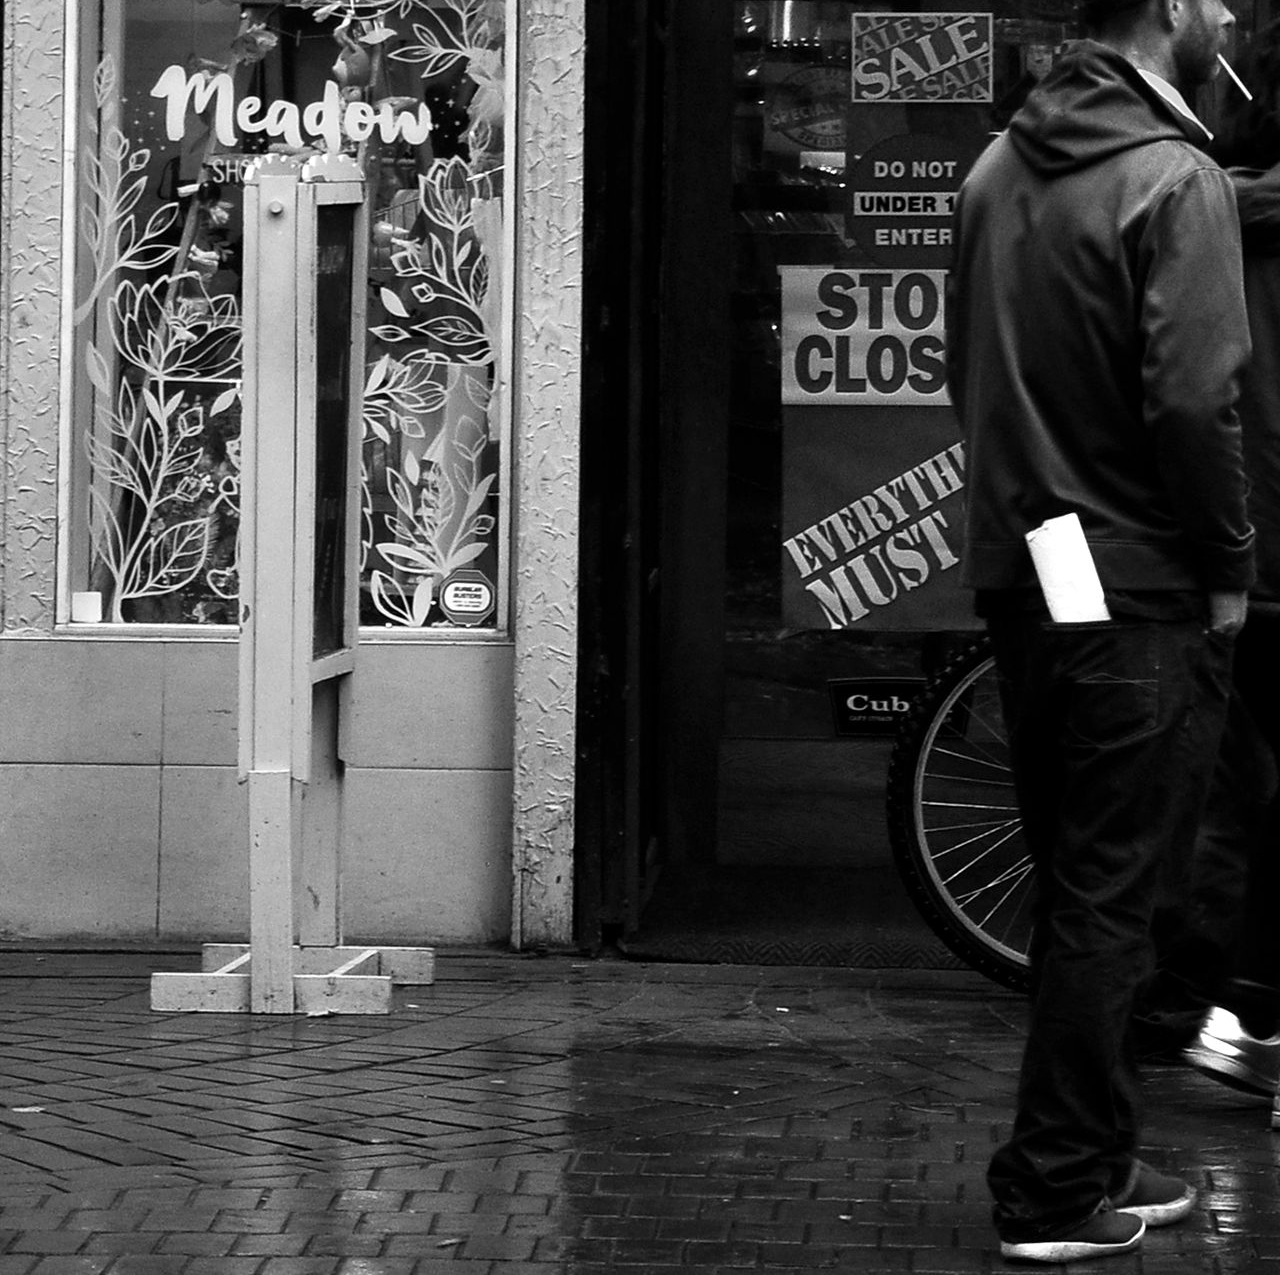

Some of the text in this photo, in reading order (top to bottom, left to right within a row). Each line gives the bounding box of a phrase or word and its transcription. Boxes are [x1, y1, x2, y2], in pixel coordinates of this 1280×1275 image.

[853, 15, 990, 100] SALE
[150, 64, 434, 155] Meadow
[875, 161, 958, 178] DO NOT
[860, 195, 937, 213] UNDER
[875, 228, 953, 246] ENTER
[816, 272, 939, 331] STO
[794, 334, 947, 394] CLOS
[805, 510, 960, 630] MUST
